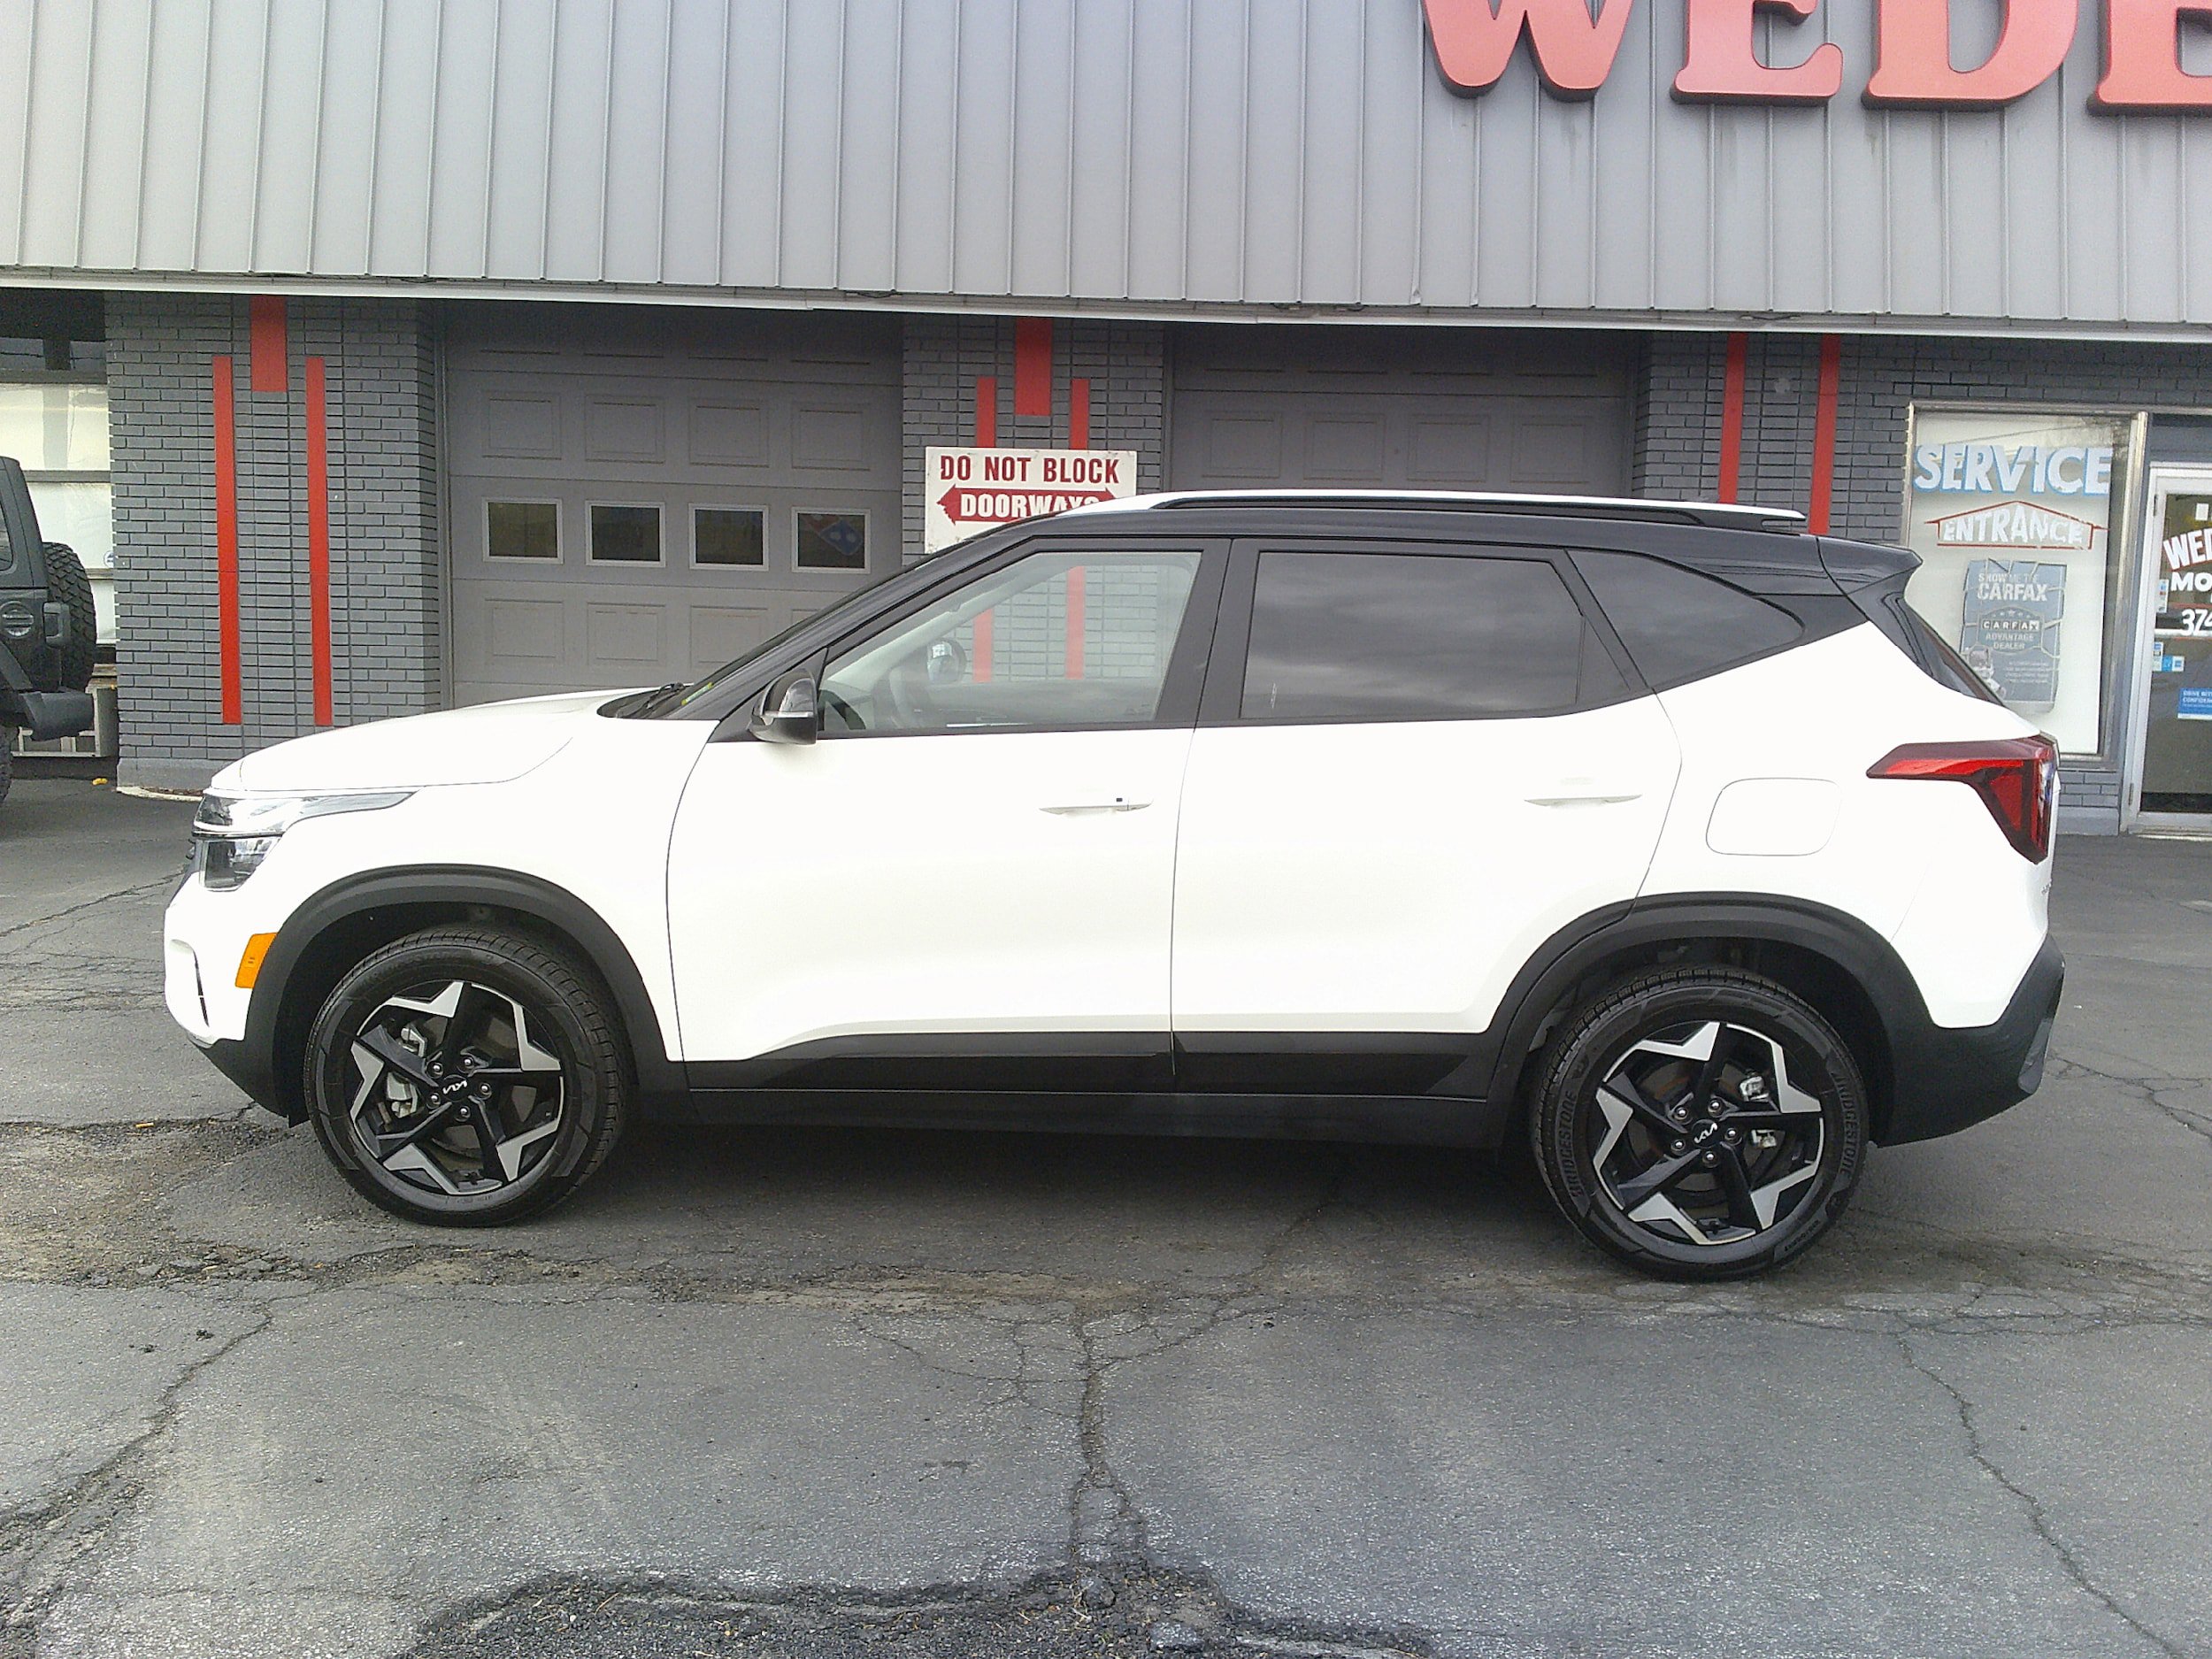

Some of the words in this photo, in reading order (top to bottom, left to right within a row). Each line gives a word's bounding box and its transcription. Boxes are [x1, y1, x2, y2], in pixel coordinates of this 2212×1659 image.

[940, 455, 972, 481] DO
[985, 456, 1032, 482] NOT
[1043, 457, 1120, 484] BLOCK
[1913, 444, 2113, 495] SERVICE
[1943, 503, 2084, 546] ENTRANCE
[1977, 582, 2047, 602] CARFAX
[1983, 621, 2039, 630] CARFAX
[1985, 633, 2034, 642] ADVANTAGE
[1993, 641, 2025, 650] DEALER
[1558, 1090, 1584, 1197] BRIDGESTONE
